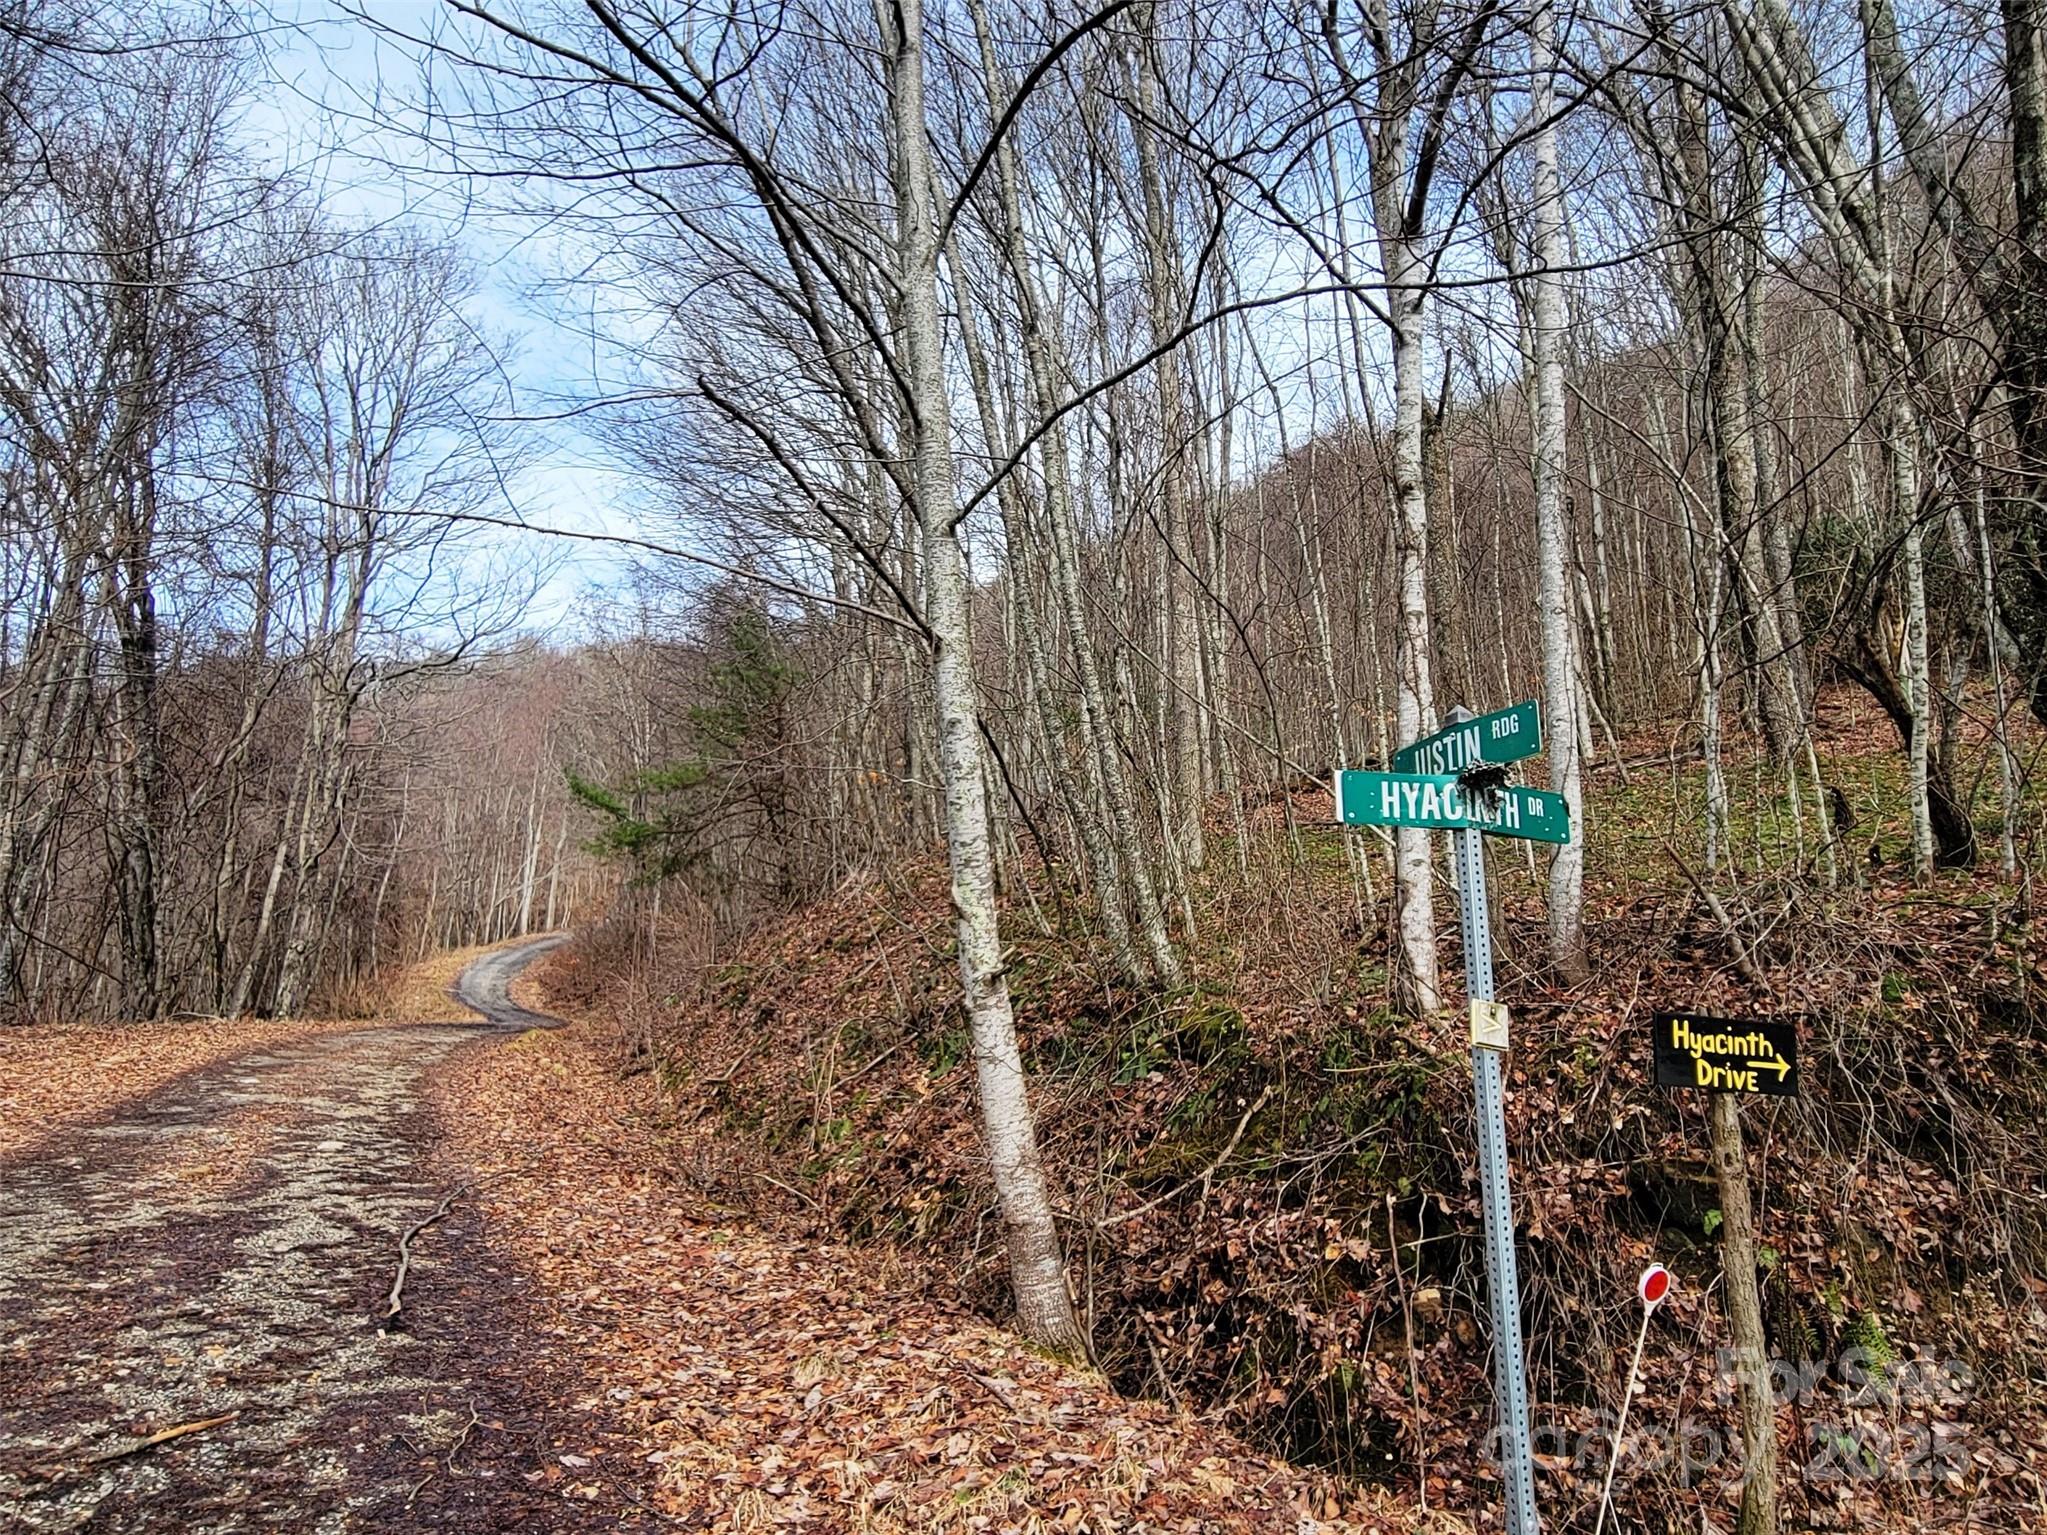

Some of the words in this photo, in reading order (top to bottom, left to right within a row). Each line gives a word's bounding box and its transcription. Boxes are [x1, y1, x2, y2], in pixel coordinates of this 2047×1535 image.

[1414, 725, 1482, 776] JUSTIN
[1491, 713, 1519, 740] RDG
[1527, 798, 1544, 818] DR
[1672, 1018, 1774, 1059] Hyacinth
